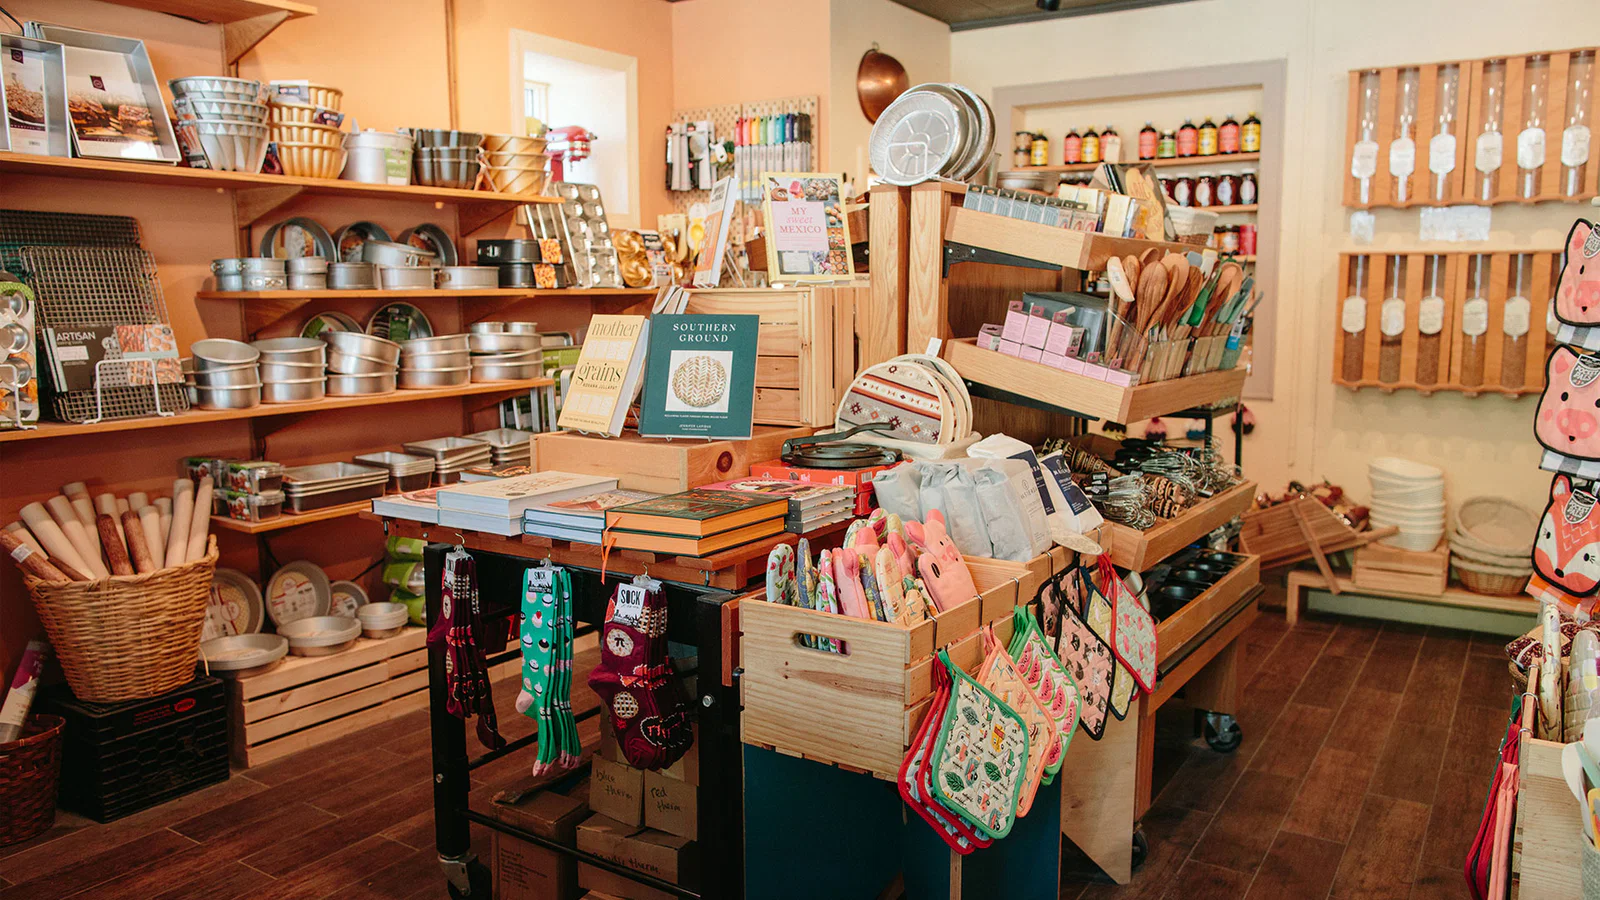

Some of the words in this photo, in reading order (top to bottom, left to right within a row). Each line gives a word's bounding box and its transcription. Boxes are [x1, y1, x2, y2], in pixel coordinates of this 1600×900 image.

[791, 207, 807, 215] MY
[787, 216, 813, 224] sweet
[780, 225, 822, 234] MEXICO
[592, 320, 638, 337] mother
[672, 323, 736, 332] SOUTHERN
[56, 331, 96, 341] ARTISAN
[679, 333, 729, 343] GROUND
[575, 362, 623, 385] grains
[620, 589, 641, 605] SOCK
[650, 787, 667, 798] red
